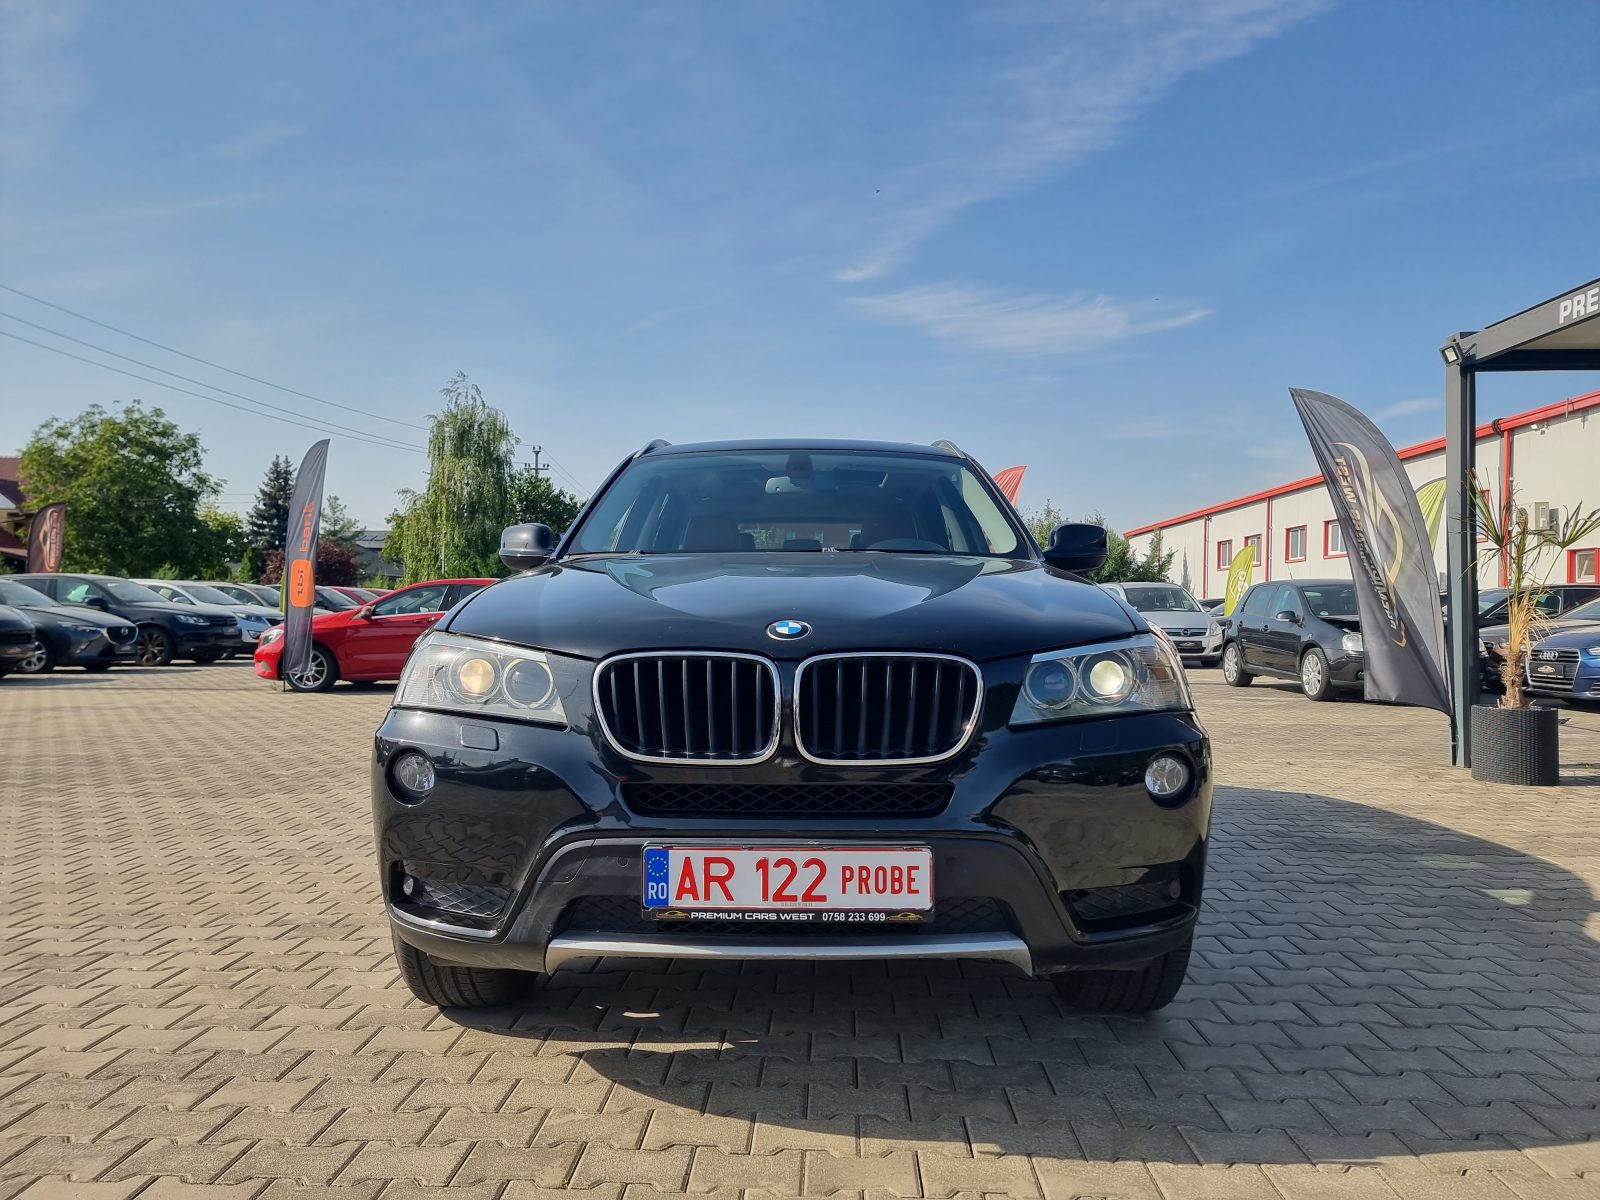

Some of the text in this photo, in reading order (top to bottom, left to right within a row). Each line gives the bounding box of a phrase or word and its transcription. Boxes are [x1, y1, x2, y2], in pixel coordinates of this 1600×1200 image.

[1559, 287, 1600, 324] PRE
[300, 500, 315, 552] bank
[648, 856, 920, 903] RO AR 122 PROBE
[690, 911, 886, 922] PREMIUM CARS WEST 0758 233 699
